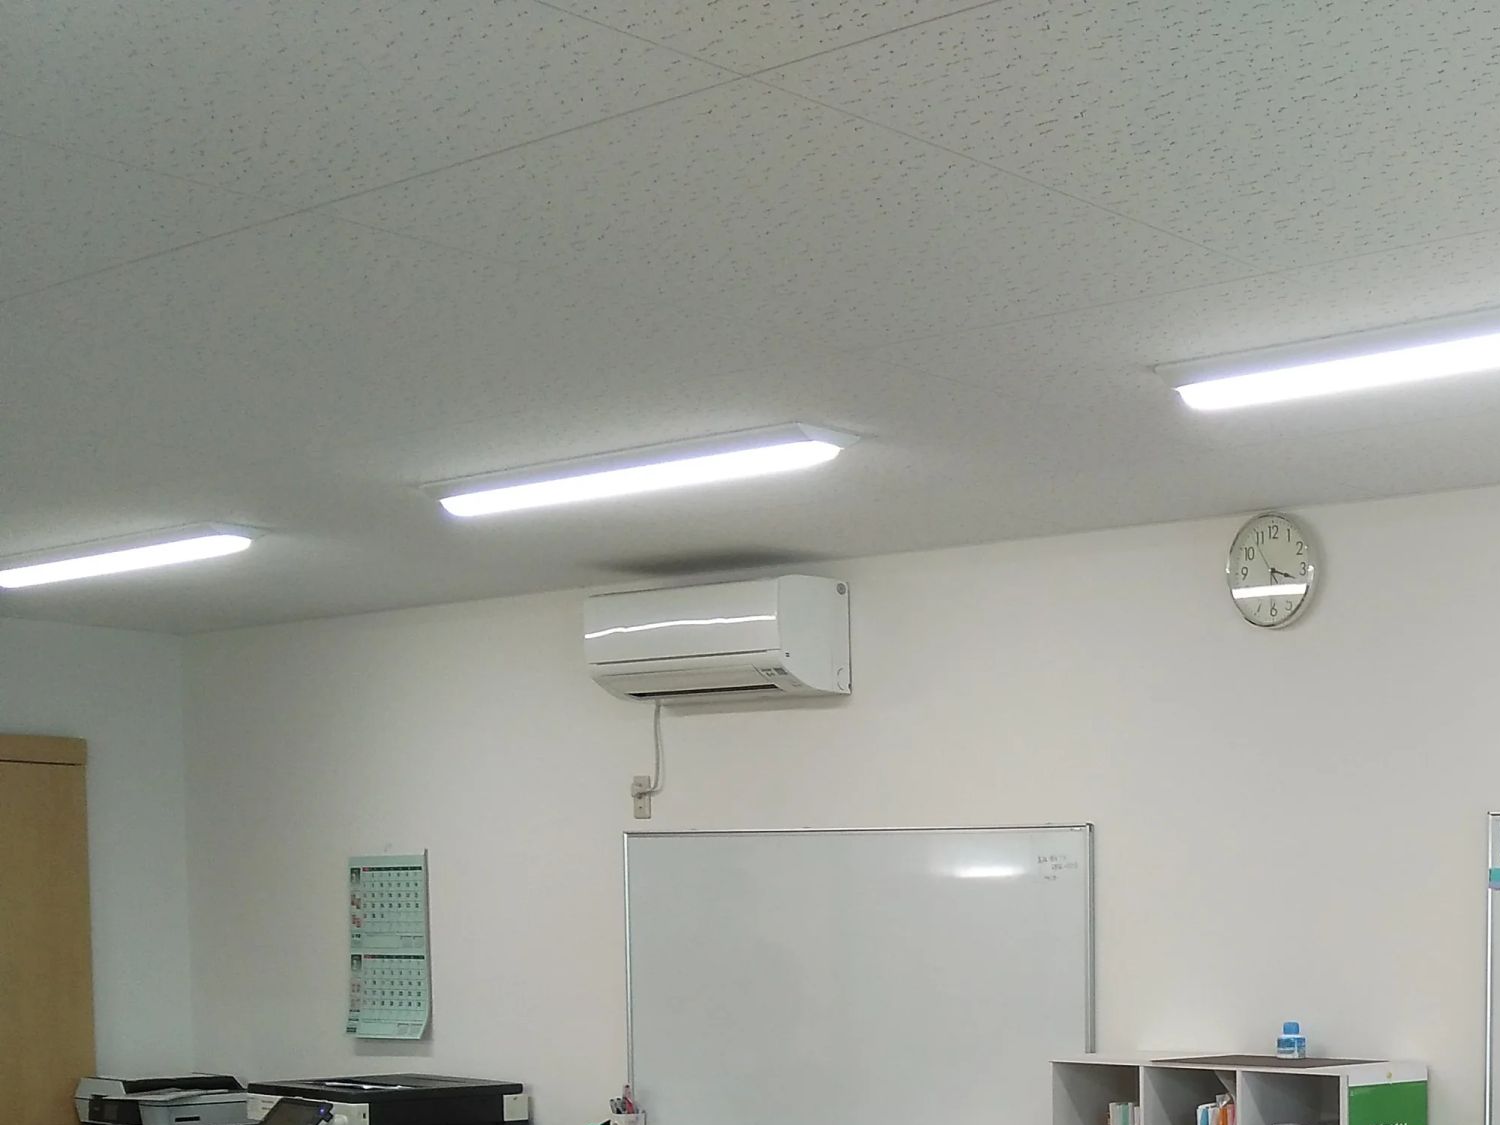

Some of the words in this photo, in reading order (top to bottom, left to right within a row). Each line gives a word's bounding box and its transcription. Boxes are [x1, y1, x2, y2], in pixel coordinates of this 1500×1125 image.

[1255, 531, 1265, 546] 11
[1268, 524, 1279, 540] 12
[1244, 546, 1255, 561] 10
[1295, 541, 1304, 556] 2
[1241, 566, 1249, 581] 9
[1299, 561, 1307, 576] 3
[1269, 602, 1278, 617] 6
